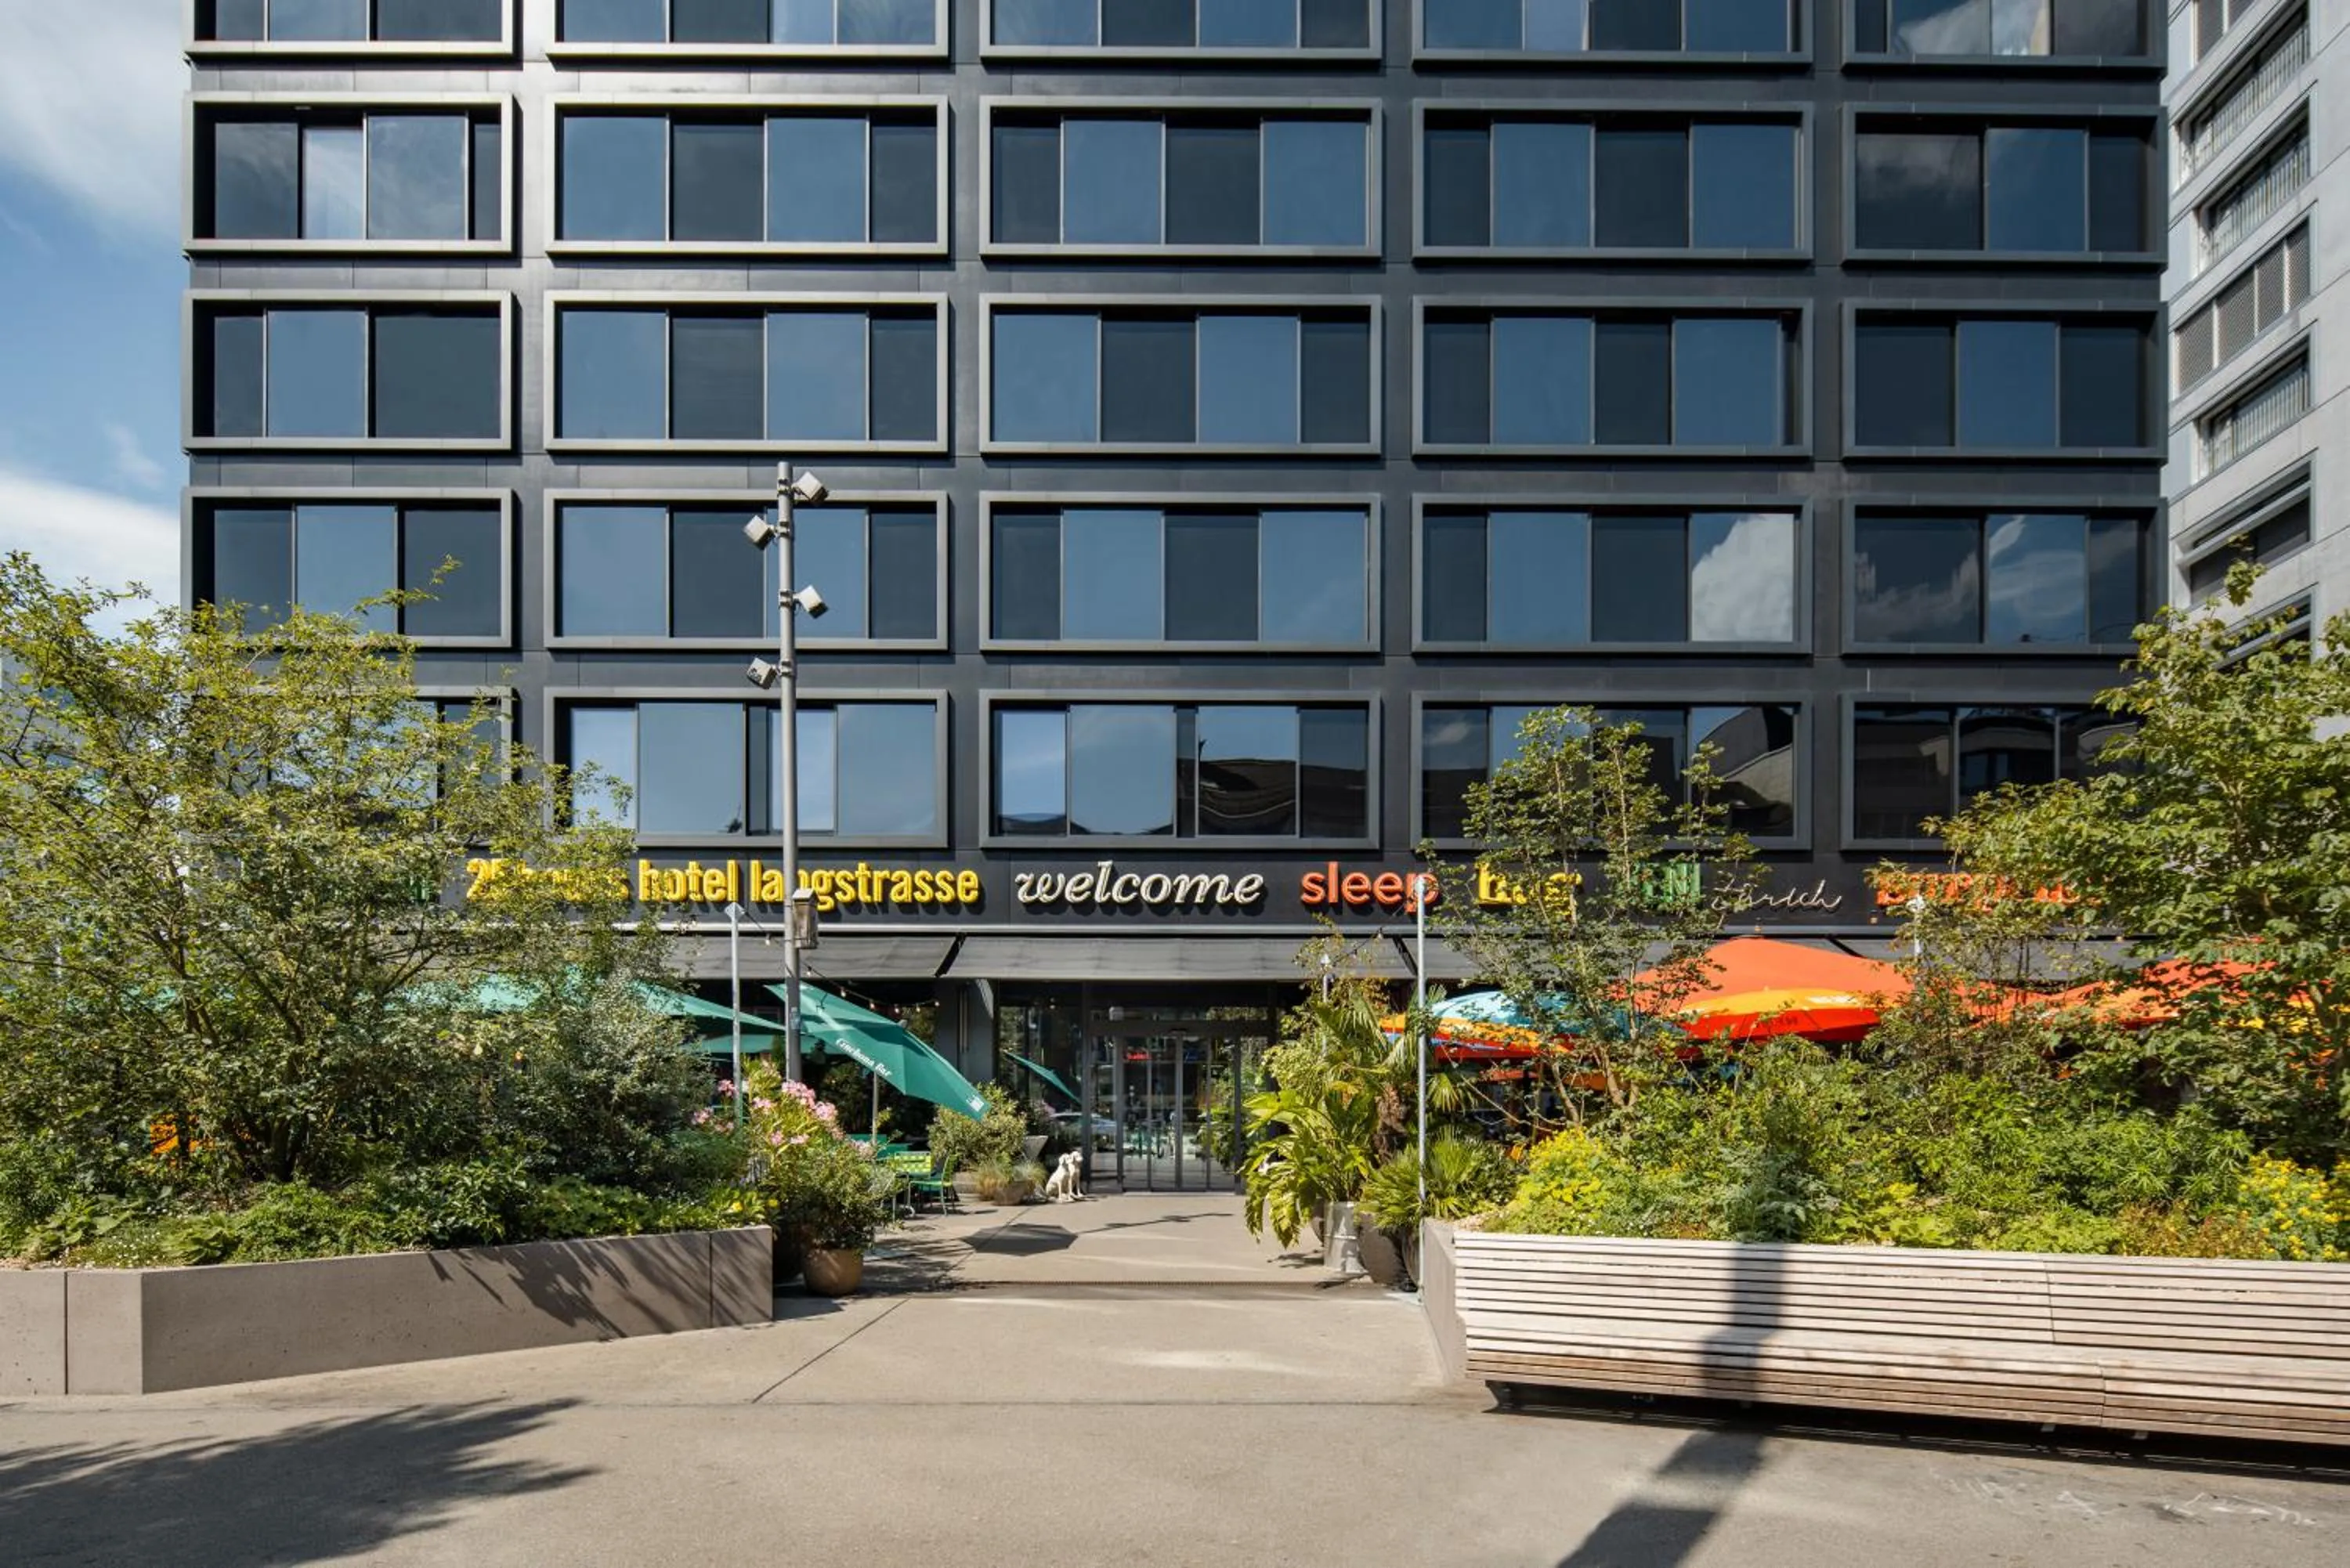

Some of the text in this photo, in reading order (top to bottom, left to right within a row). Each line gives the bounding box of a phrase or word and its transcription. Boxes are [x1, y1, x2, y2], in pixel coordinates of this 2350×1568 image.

[638, 859, 738, 902] hotel
[1015, 860, 1264, 904] welcome
[1300, 862, 1440, 914] sleep
